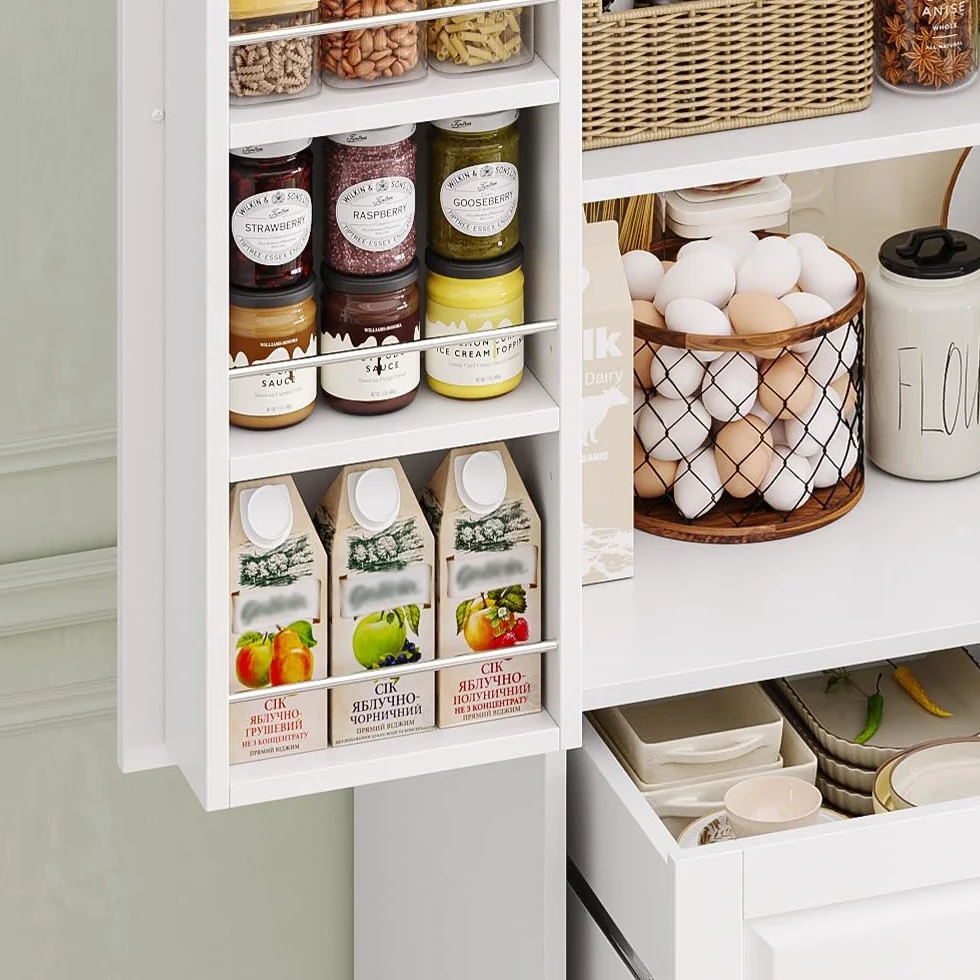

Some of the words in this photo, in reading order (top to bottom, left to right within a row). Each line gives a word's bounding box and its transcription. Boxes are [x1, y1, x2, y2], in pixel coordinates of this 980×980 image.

[921, 1, 965, 17] ANISE
[932, 22, 958, 31] WHOLE
[447, 171, 470, 189] WILKIN
[472, 169, 478, 177] &
[343, 186, 366, 204] WILKIN
[453, 191, 514, 208] GOOSEBERRY
[238, 198, 262, 216] WILKIN
[263, 196, 269, 204] &
[353, 203, 407, 220] RASPBERRY
[245, 215, 306, 233] STRAWBERRY
[448, 210, 470, 229] TIPTREE
[473, 224, 496, 232] ESSEX
[343, 225, 366, 245] TIPTREE
[368, 239, 391, 247] ESSEX
[239, 238, 264, 258] TIPTREE
[265, 252, 287, 260] ESSEX
[436, 347, 450, 356] ICE
[454, 349, 490, 358] CREAM
[582, 327, 622, 360] lk
[365, 361, 399, 373] SAUCE
[585, 369, 623, 387] Dairy
[481, 660, 504, 675] СІК
[374, 682, 397, 696] СІК
[458, 671, 526, 693] ЯБЛУЧНО-
[453, 681, 531, 705] ПОЛУНИЧНИЙ
[264, 697, 287, 711] СІК
[352, 692, 420, 713] ЯБЛУЧНО-
[454, 706, 465, 715] НЕ
[472, 695, 528, 712] КОНЦЕНТРАТУ
[250, 709, 302, 725] ЯБЛУЧНО-
[350, 703, 422, 725] ЧОРНИЧНИЙ
[462, 709, 492, 721] ПРЯМИЙ
[492, 705, 521, 717] ВІДЖИМ
[245, 718, 303, 738] ГРУШЕВИЙ
[356, 722, 385, 734] ПРЯМИЙ
[386, 719, 415, 730] ВІДЖИМ
[242, 740, 251, 749] НЕ
[257, 731, 309, 746] КОНЦЕНТРАТУ
[250, 747, 274, 757] ПРЯМИЙ
[275, 744, 300, 753] ВІДЖИМ
